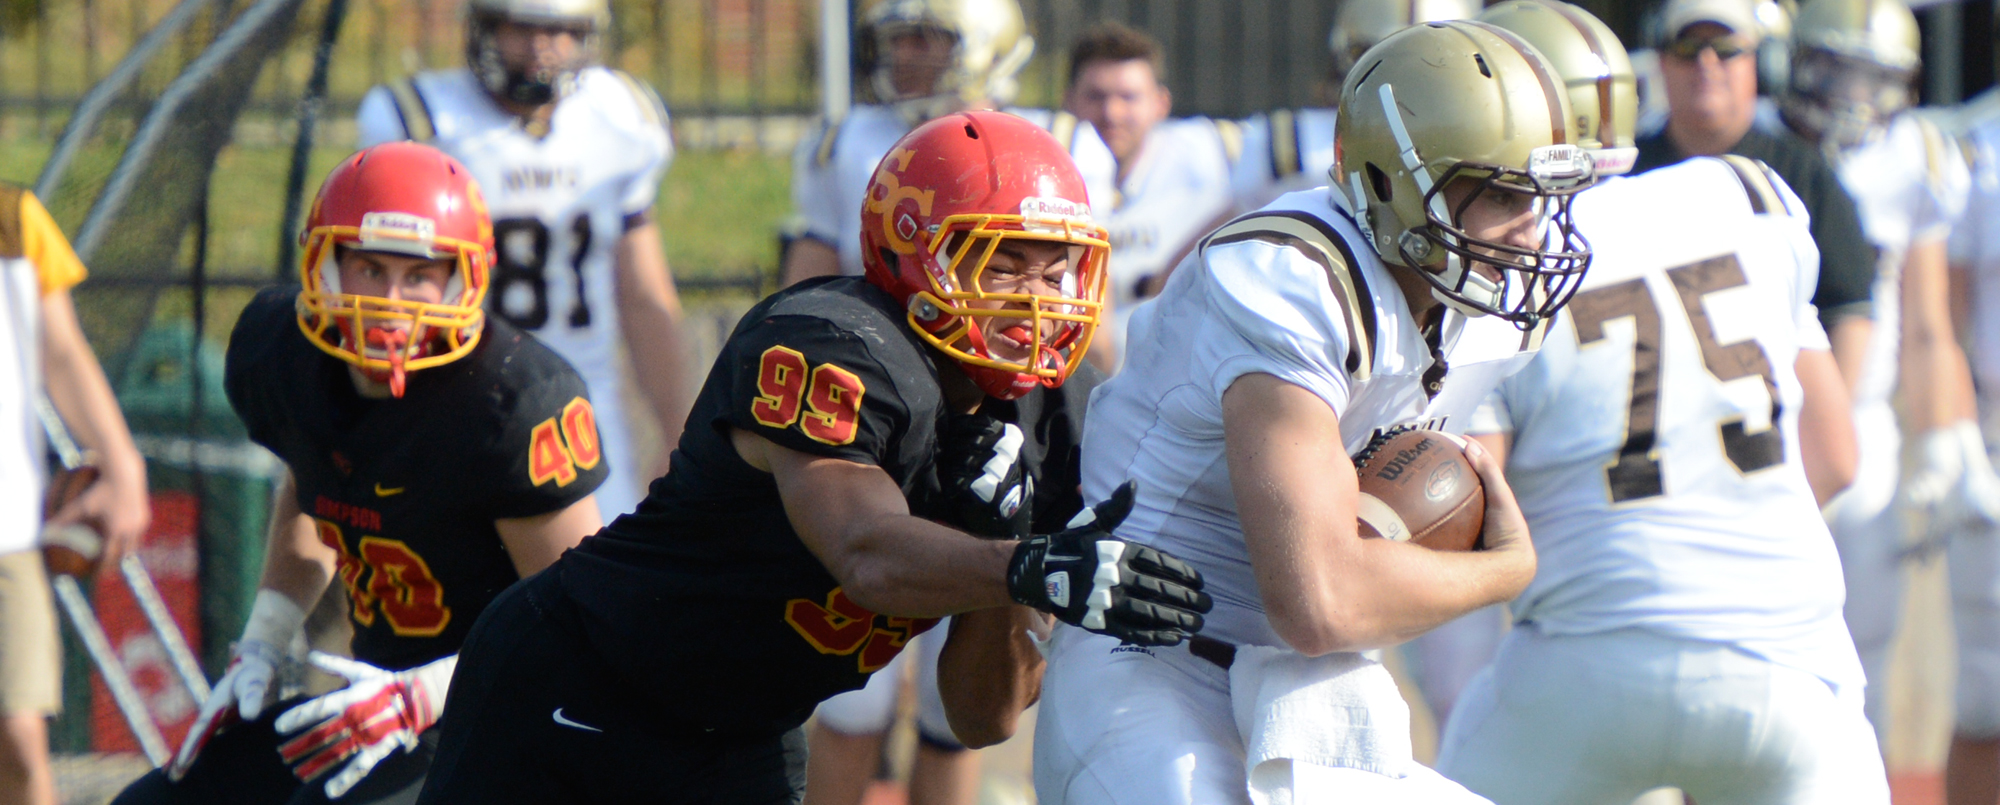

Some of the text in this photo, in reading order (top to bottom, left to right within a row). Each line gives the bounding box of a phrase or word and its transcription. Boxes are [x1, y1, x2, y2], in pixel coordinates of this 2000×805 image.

[1038, 201, 1076, 216] Riddell
[491, 216, 591, 330] 81
[751, 344, 865, 446] 99
[1567, 253, 1787, 506] 75
[528, 395, 601, 488] 40
[1376, 437, 1436, 481] Wilson
